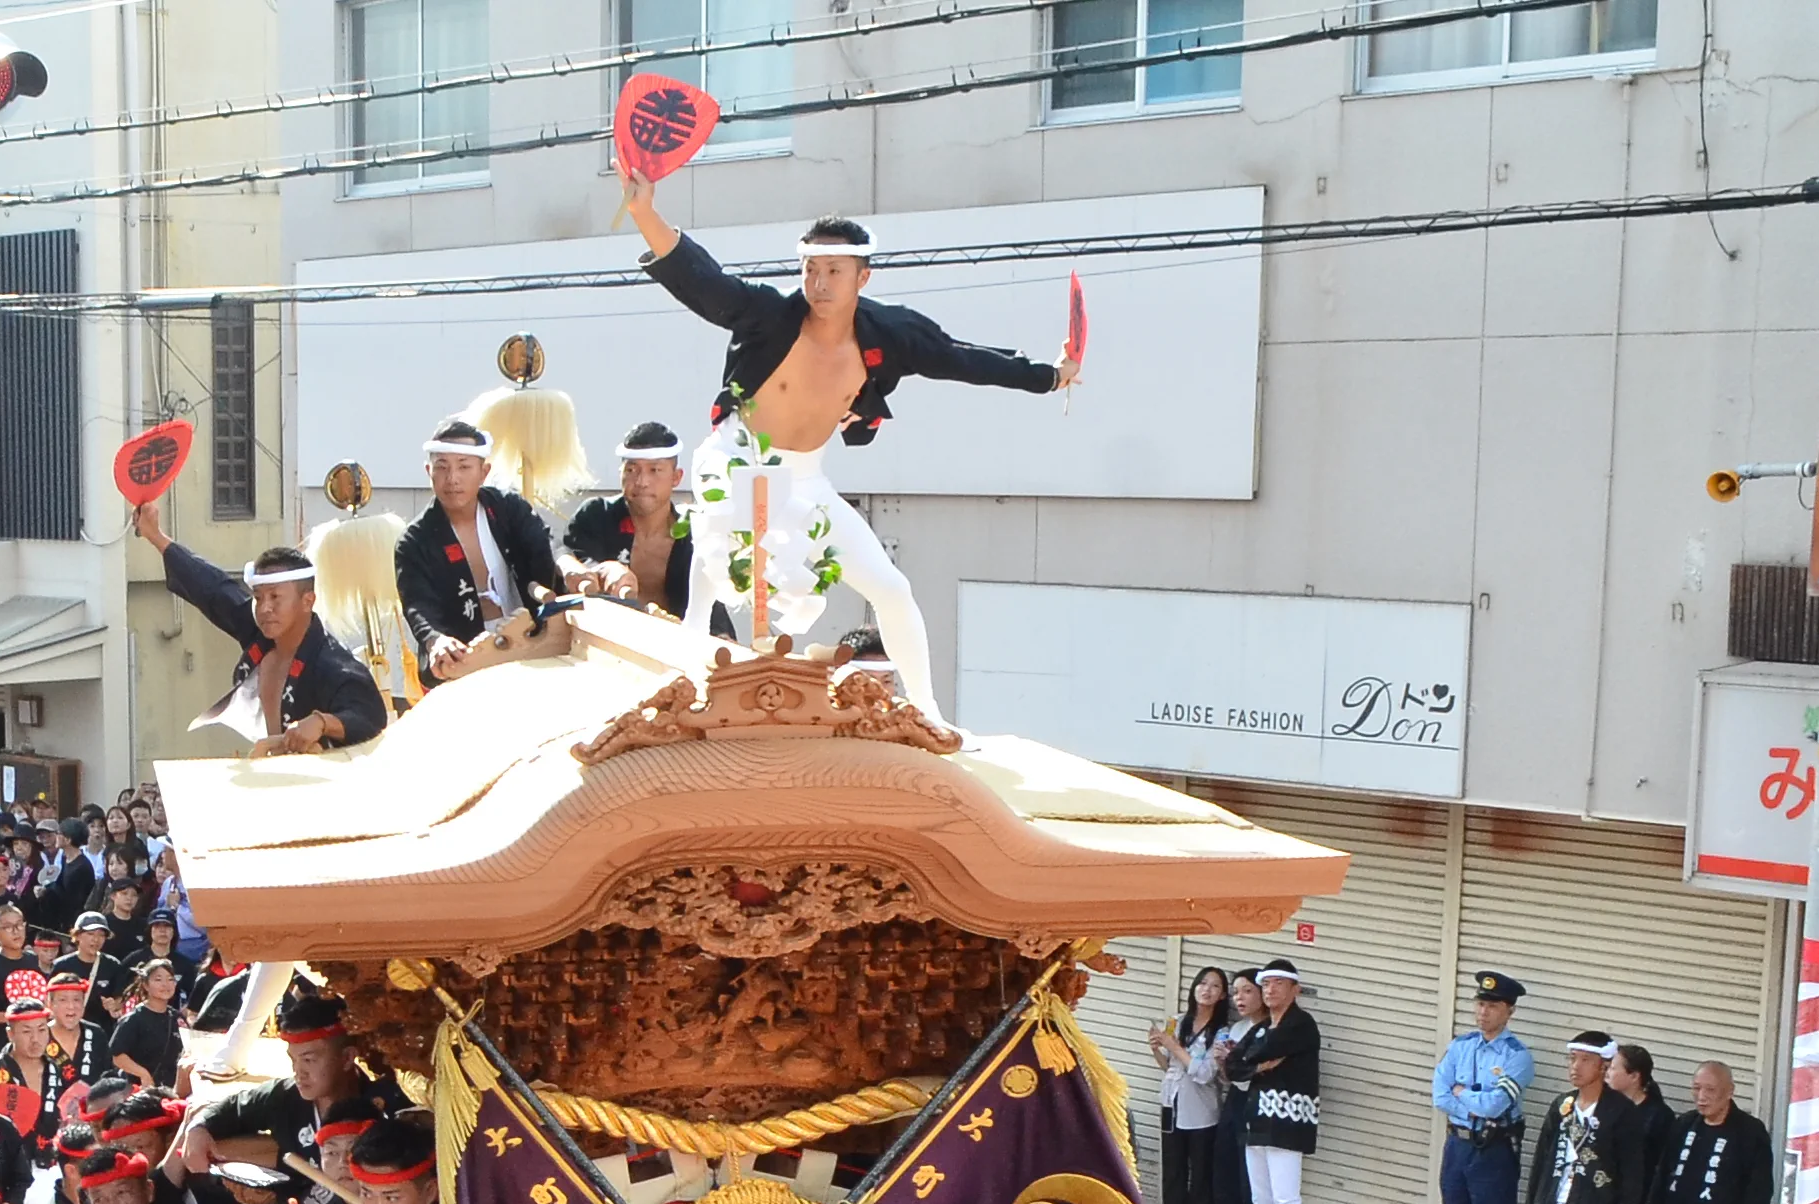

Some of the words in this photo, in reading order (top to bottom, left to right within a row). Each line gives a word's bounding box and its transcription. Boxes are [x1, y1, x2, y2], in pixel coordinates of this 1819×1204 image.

[457, 578, 479, 622] 土井
[1150, 702, 1215, 725] LADISE
[1227, 708, 1305, 733] FASHION
[1331, 676, 1443, 744] Don
[1399, 682, 1457, 714] ドン
[1759, 747, 1816, 820] み
[912, 1107, 994, 1199] 大町
